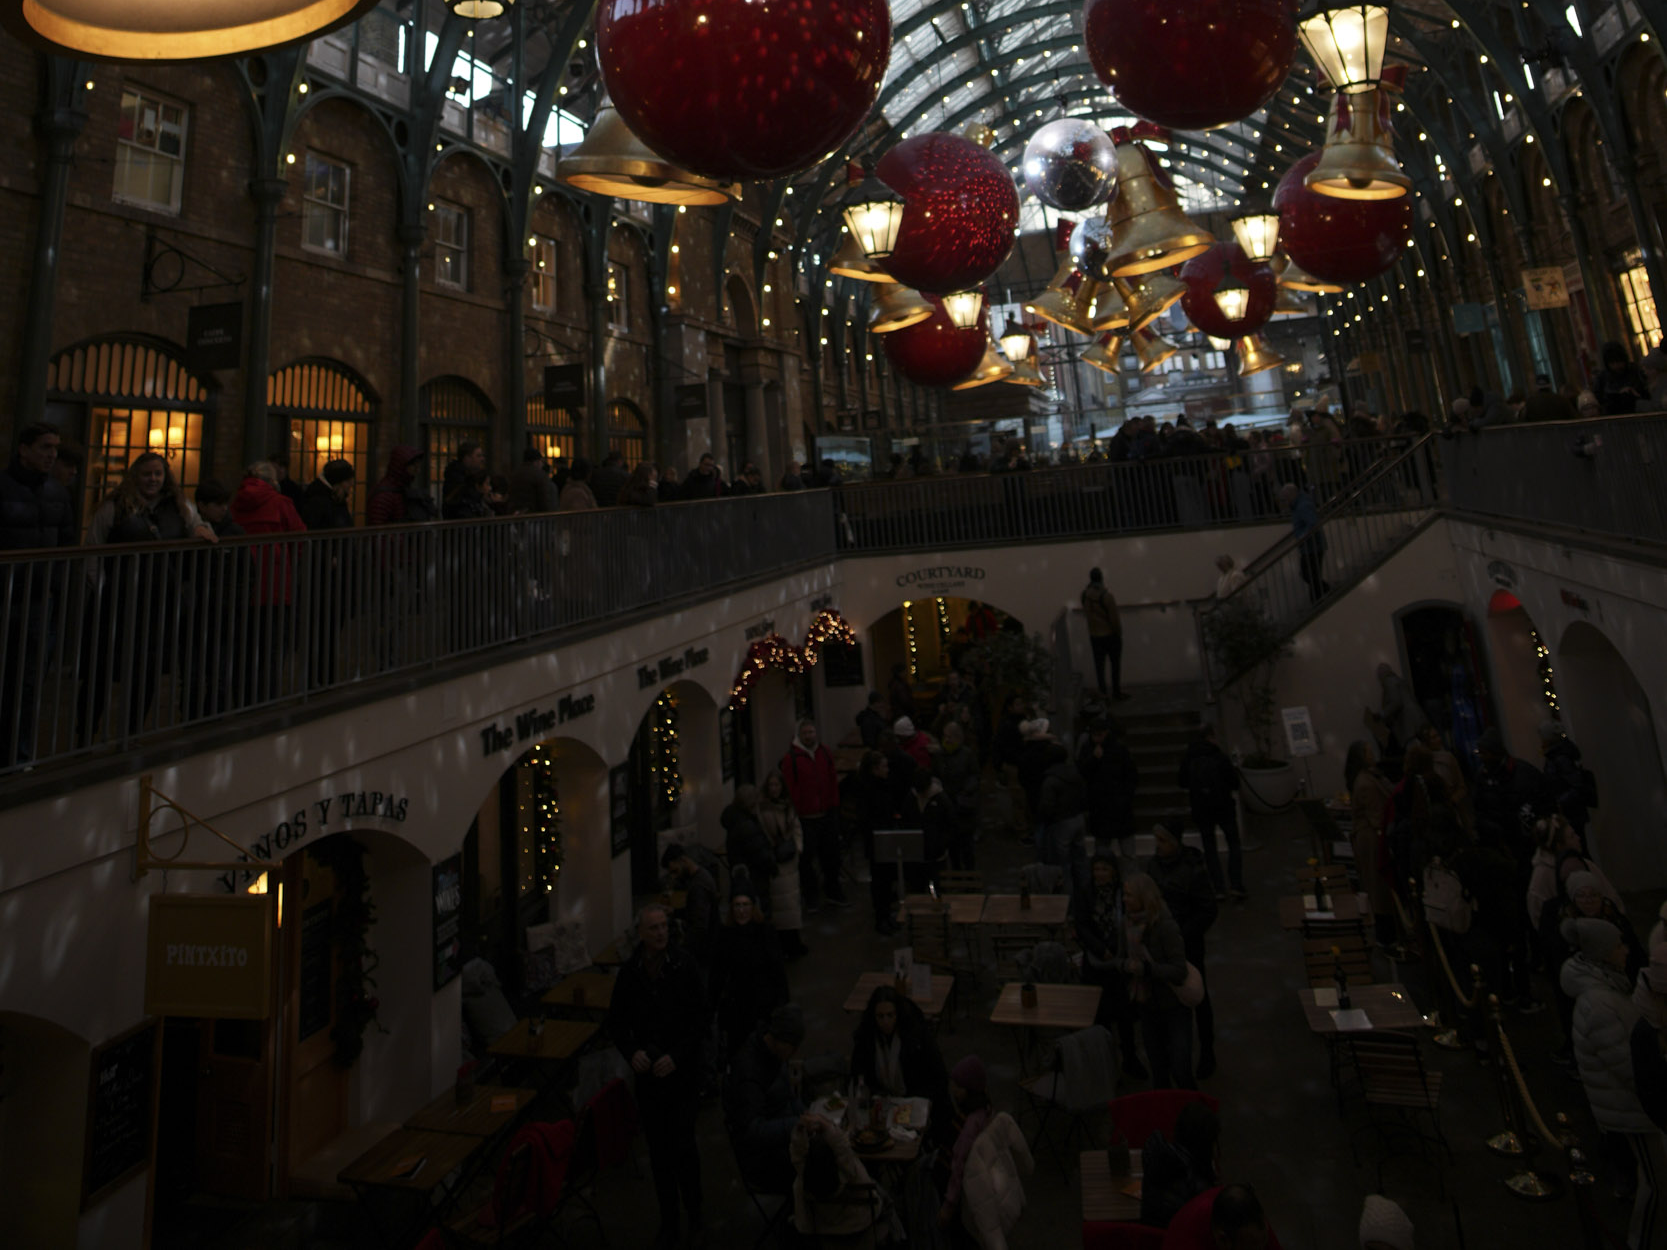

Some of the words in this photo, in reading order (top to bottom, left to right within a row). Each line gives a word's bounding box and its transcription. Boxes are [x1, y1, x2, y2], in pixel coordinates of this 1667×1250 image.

[896, 565, 986, 588] COURTYARD
[481, 723, 513, 758] The
[516, 708, 556, 741] Wine
[558, 694, 595, 726] Place
[315, 798, 333, 825] Y
[338, 791, 409, 823] TAPAS
